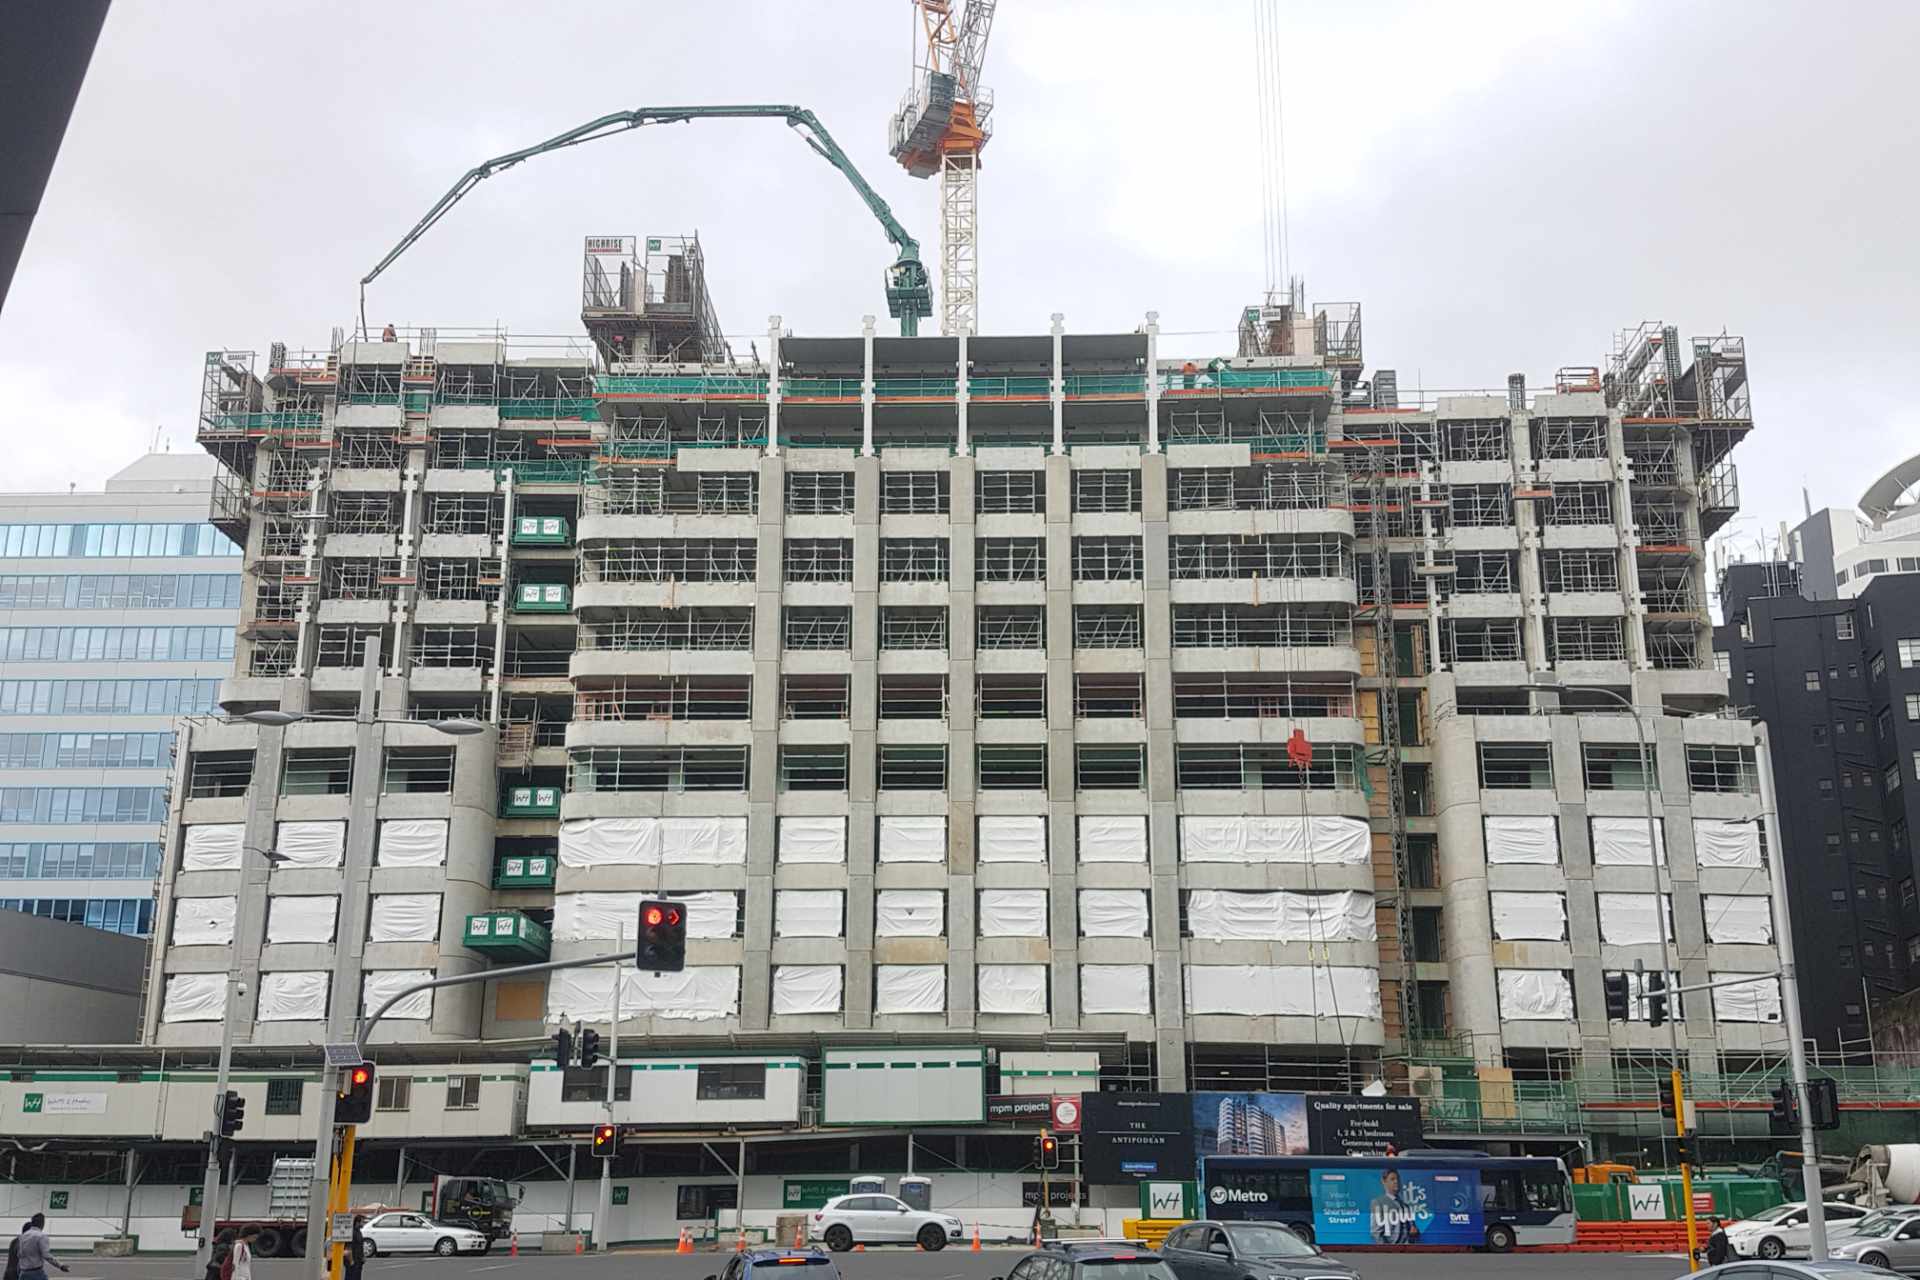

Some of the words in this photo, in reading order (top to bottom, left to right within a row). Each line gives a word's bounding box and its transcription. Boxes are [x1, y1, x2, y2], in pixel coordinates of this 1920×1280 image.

[991, 1105, 1013, 1114] mpm
[1014, 1103, 1049, 1113] projects
[1314, 1102, 1341, 1111] Quality
[1343, 1103, 1384, 1111] apartments
[1229, 1189, 1268, 1202] Metro
[1402, 1181, 1426, 1203] it's
[1153, 1192, 1180, 1210] WH
[1632, 1193, 1661, 1211] WH
[1328, 1216, 1356, 1224] Street?
